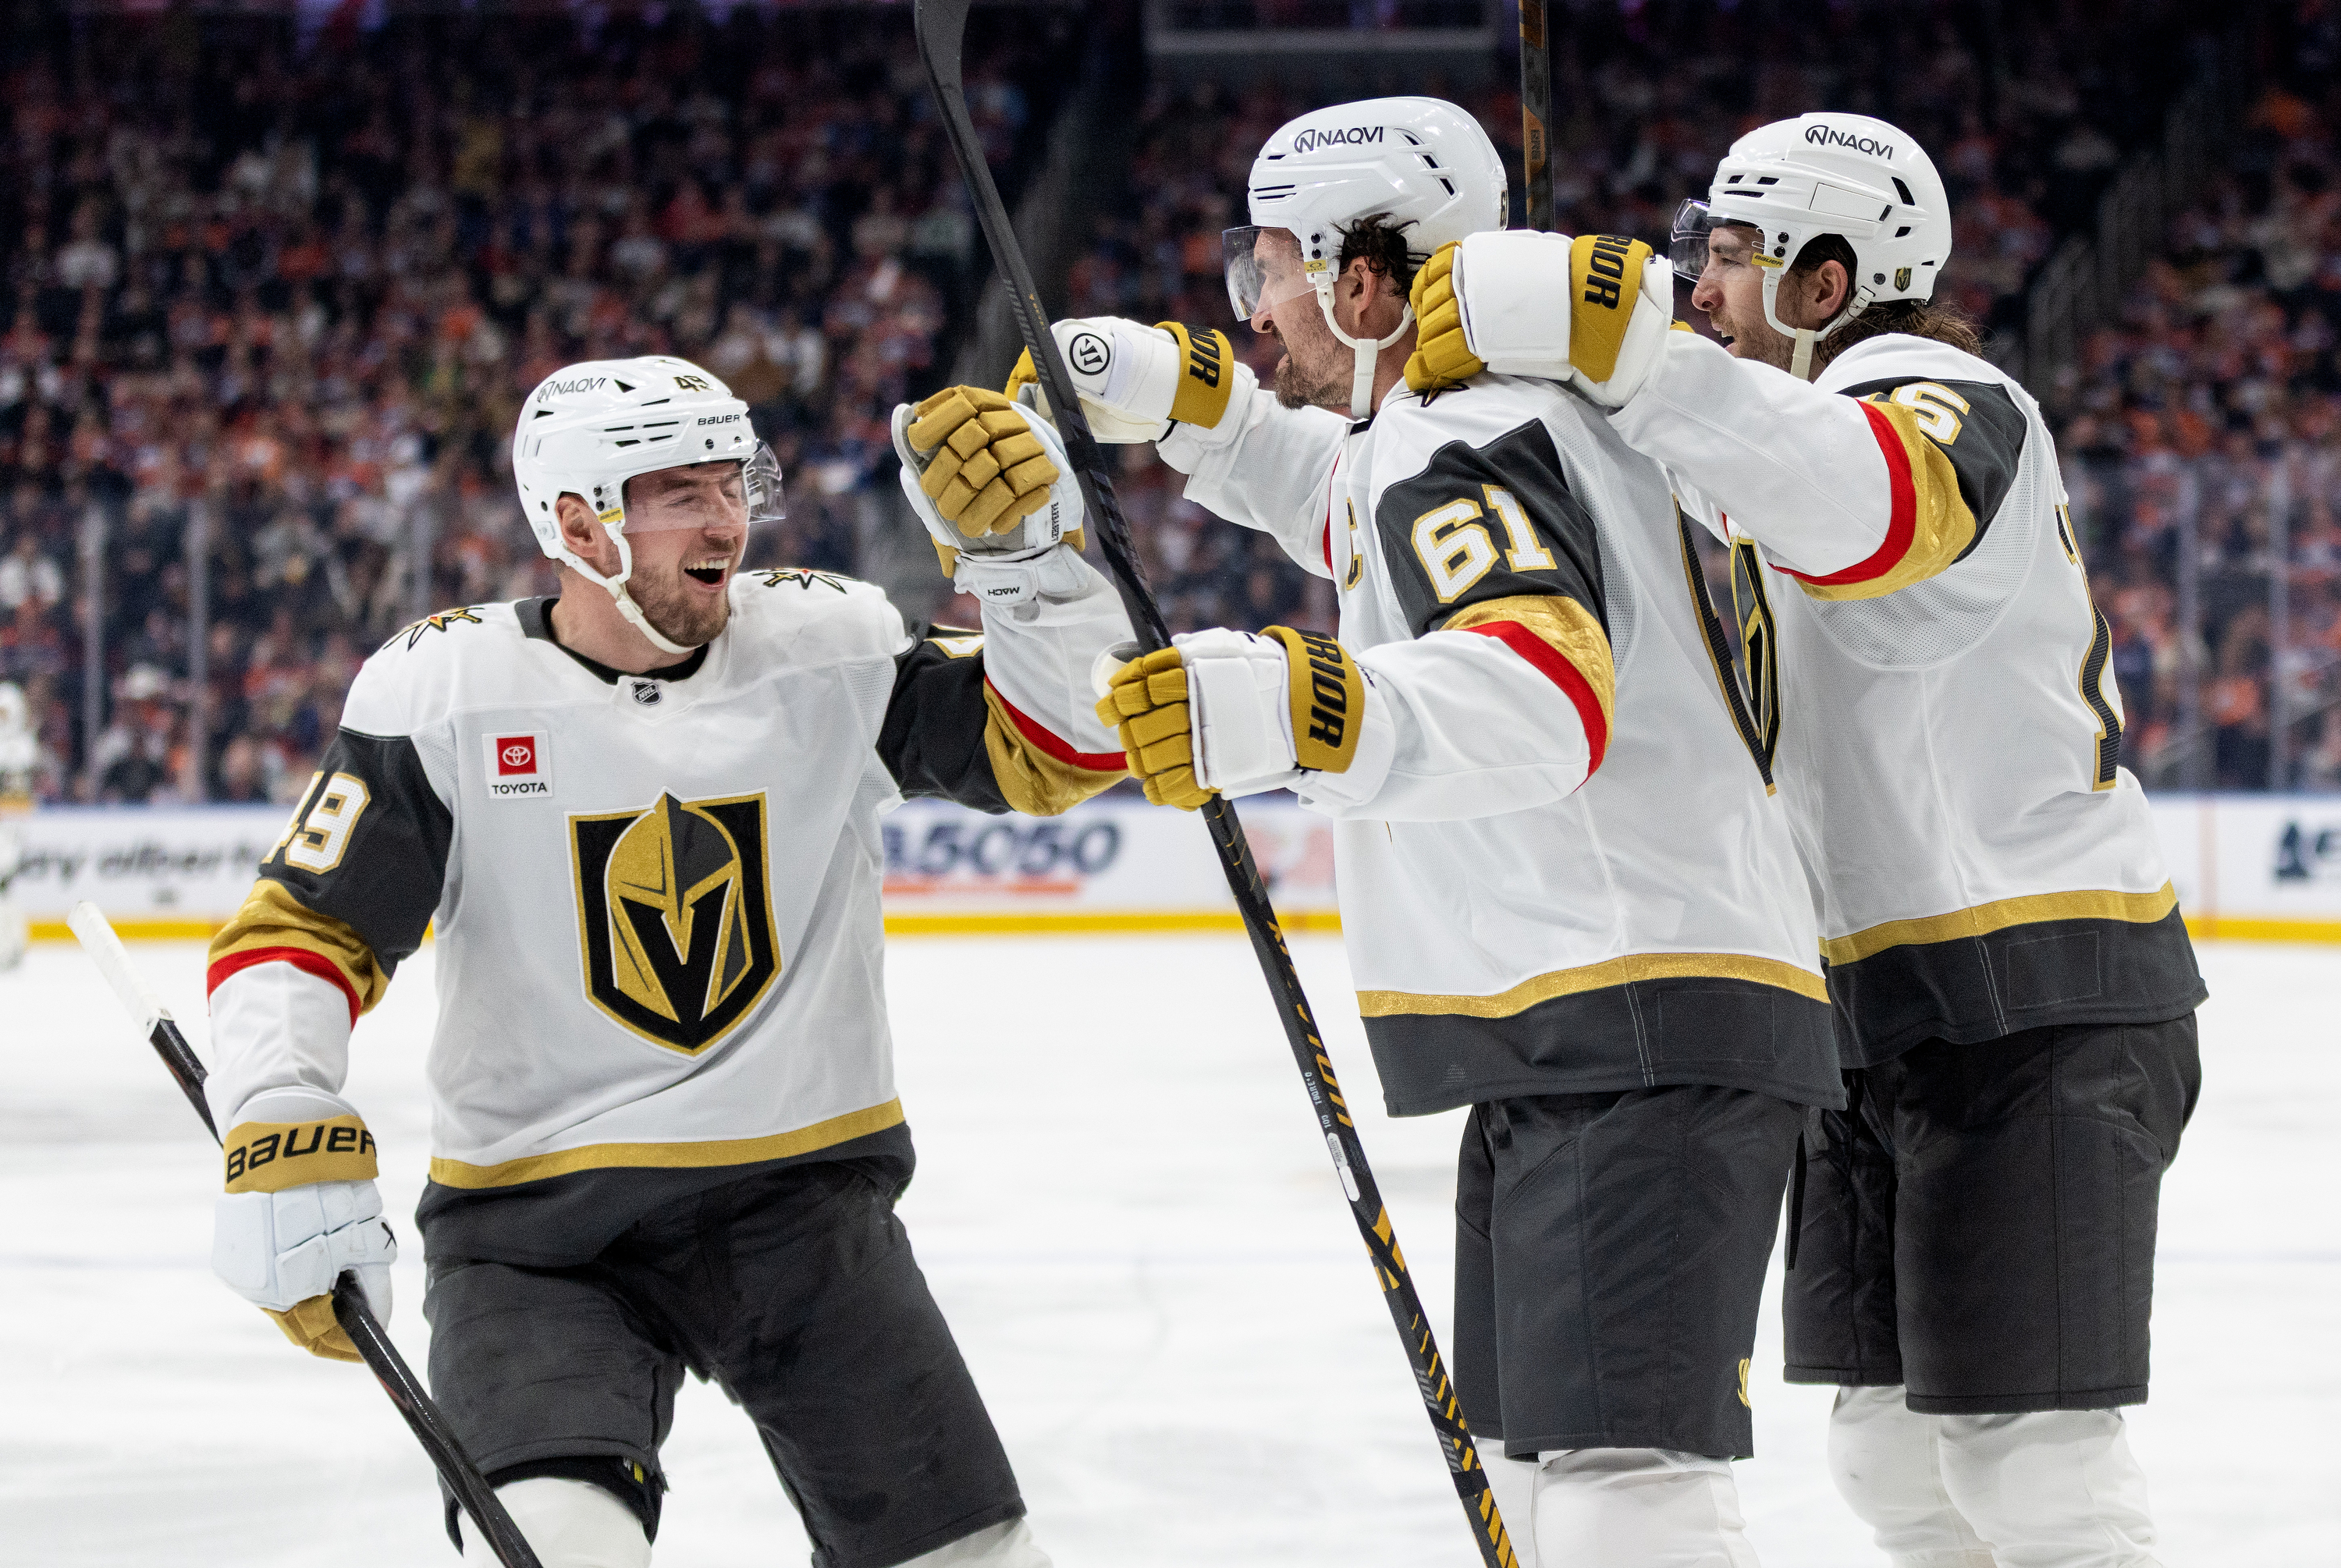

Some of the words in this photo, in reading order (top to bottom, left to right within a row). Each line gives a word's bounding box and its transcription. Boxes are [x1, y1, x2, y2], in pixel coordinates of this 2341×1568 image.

[1316, 126, 1384, 147] NAQVI
[1828, 129, 1894, 160] NAQVI
[552, 378, 607, 396] NAQVI
[1409, 484, 1559, 605] 61
[638, 686, 656, 701] NHL
[492, 782, 548, 795] TOYOTA
